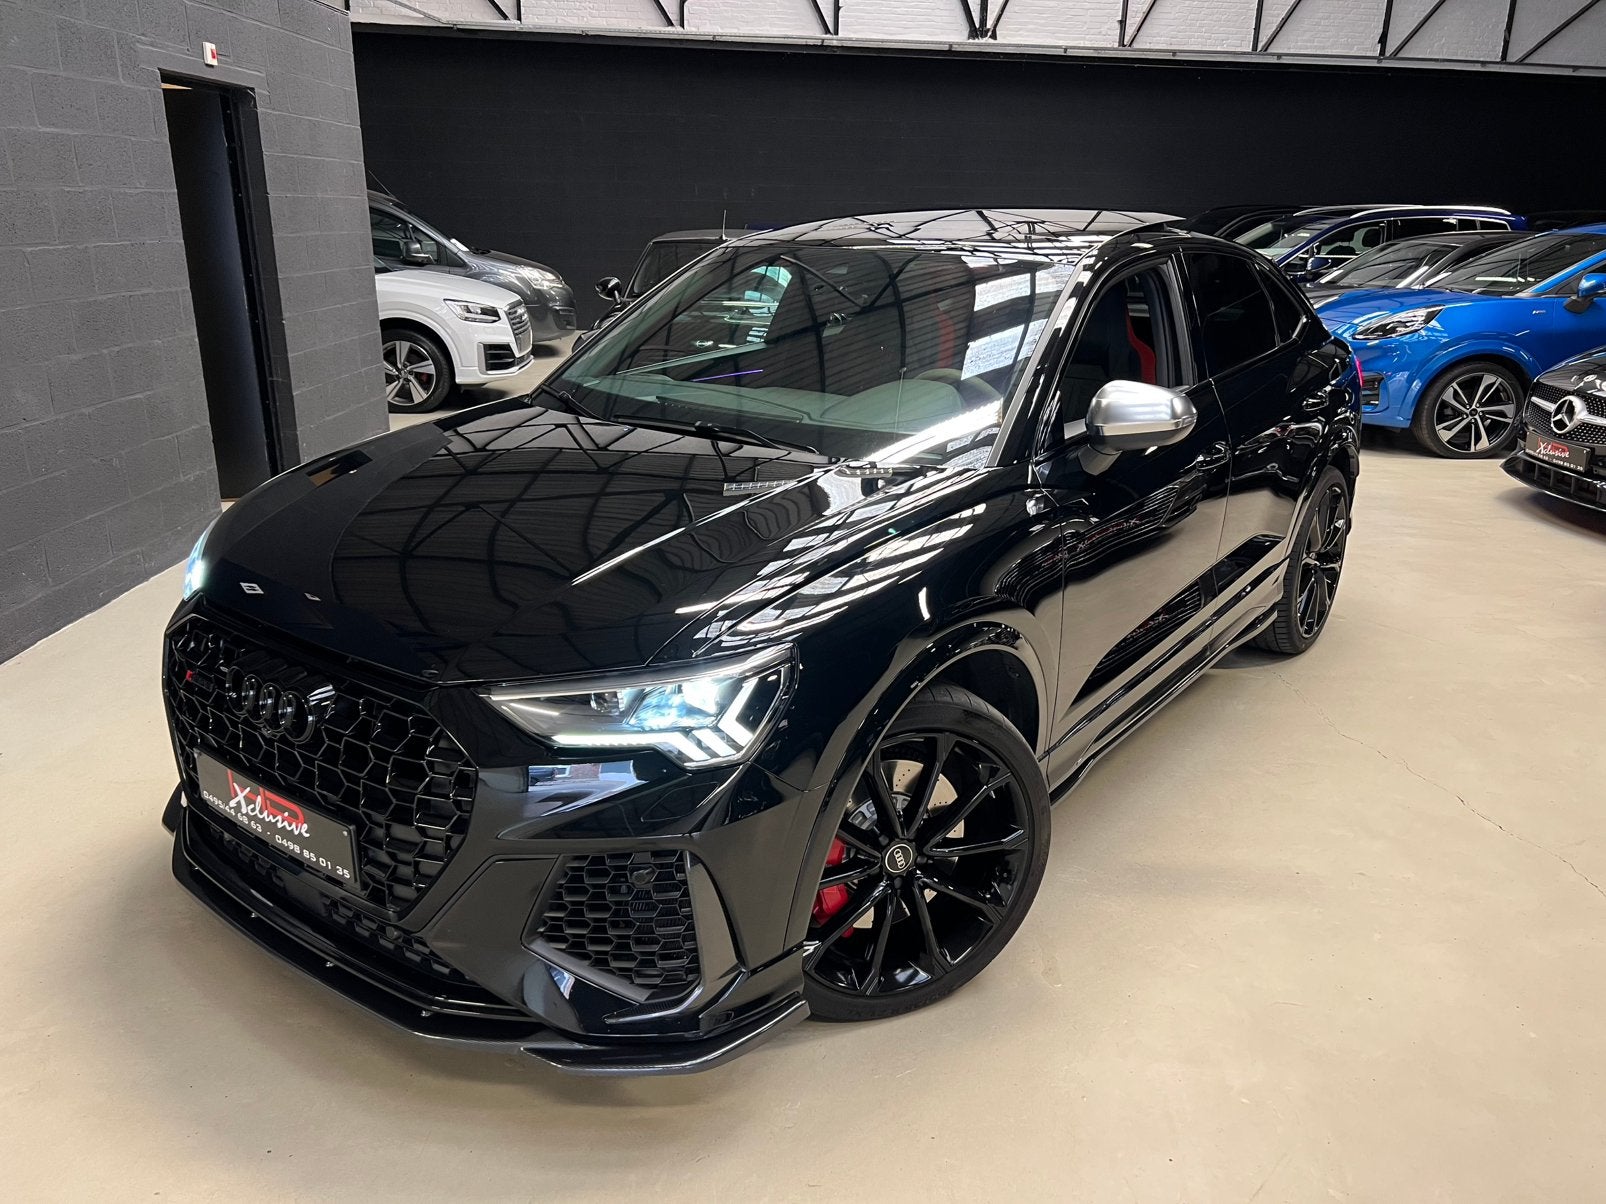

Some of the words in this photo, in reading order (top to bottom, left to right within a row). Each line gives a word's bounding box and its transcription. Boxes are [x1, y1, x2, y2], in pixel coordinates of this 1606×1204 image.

[1535, 441, 1570, 458] Xclusive
[229, 782, 311, 838] Xclusive
[275, 834, 301, 854] 0498
[303, 848, 317, 862] 85
[319, 857, 332, 870] 01
[336, 865, 351, 879] 35
